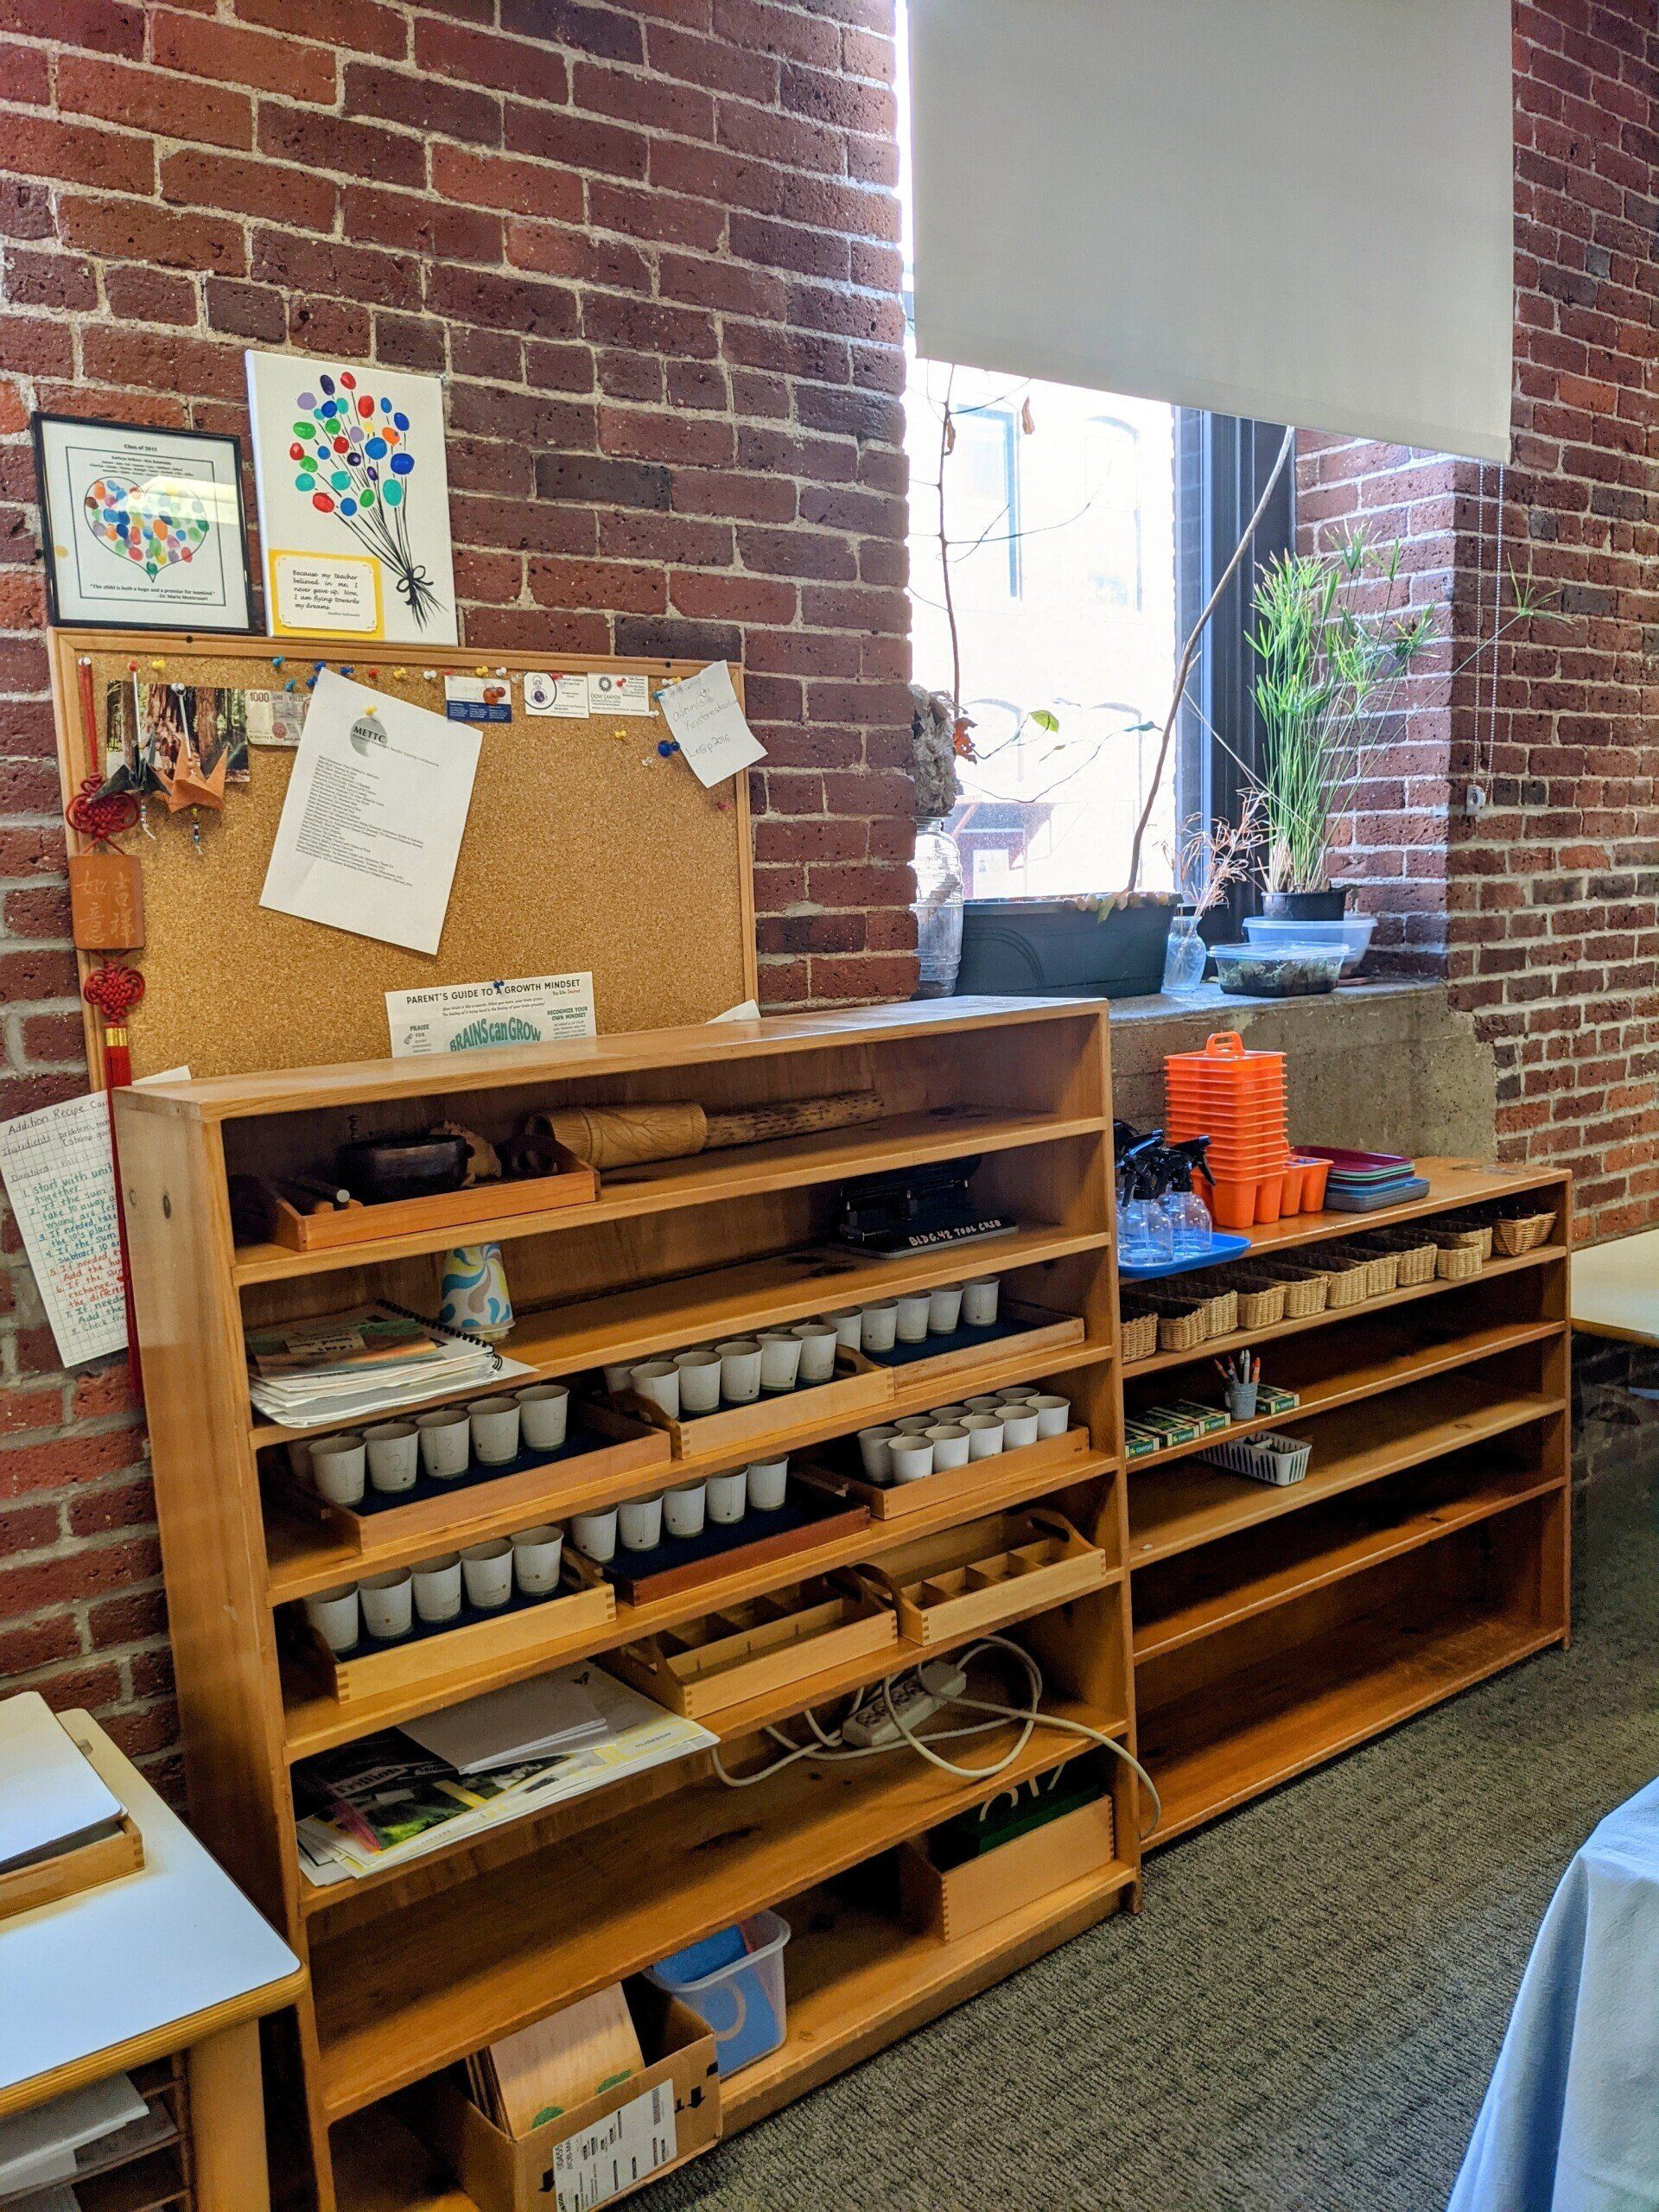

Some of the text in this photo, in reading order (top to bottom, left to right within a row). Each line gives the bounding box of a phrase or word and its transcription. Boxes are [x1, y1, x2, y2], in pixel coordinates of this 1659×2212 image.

[314, 595, 333, 604] flying
[250, 692, 270, 702] 1000
[353, 726, 385, 743] METTC
[406, 979, 581, 1004] PARENT'S GUIDE TO A GROWTH MINDSET
[449, 1016, 542, 1052] BRAINS can GROW
[8, 1105, 86, 1135] Addition Recipe
[33, 1179, 58, 1195] start
[61, 1172, 87, 1187] with
[61, 1195, 79, 1206] the
[86, 1189, 107, 1199] sum
[41, 1198, 105, 1221] take 10 away
[45, 1211, 96, 1230] many are
[63, 1218, 93, 1234] needed
[97, 1212, 118, 1223] take
[954, 1225, 977, 1236] TOOL
[51, 1237, 66, 1247] the
[74, 1240, 90, 1249] the
[95, 1232, 117, 1243] sum
[58, 1247, 94, 1263] subtract
[77, 1251, 108, 1268] needed
[64, 1269, 83, 1281] Add
[87, 1264, 104, 1274] the
[86, 1274, 101, 1283] the
[67, 1299, 85, 1308] the
[78, 1305, 124, 1324] Add the
